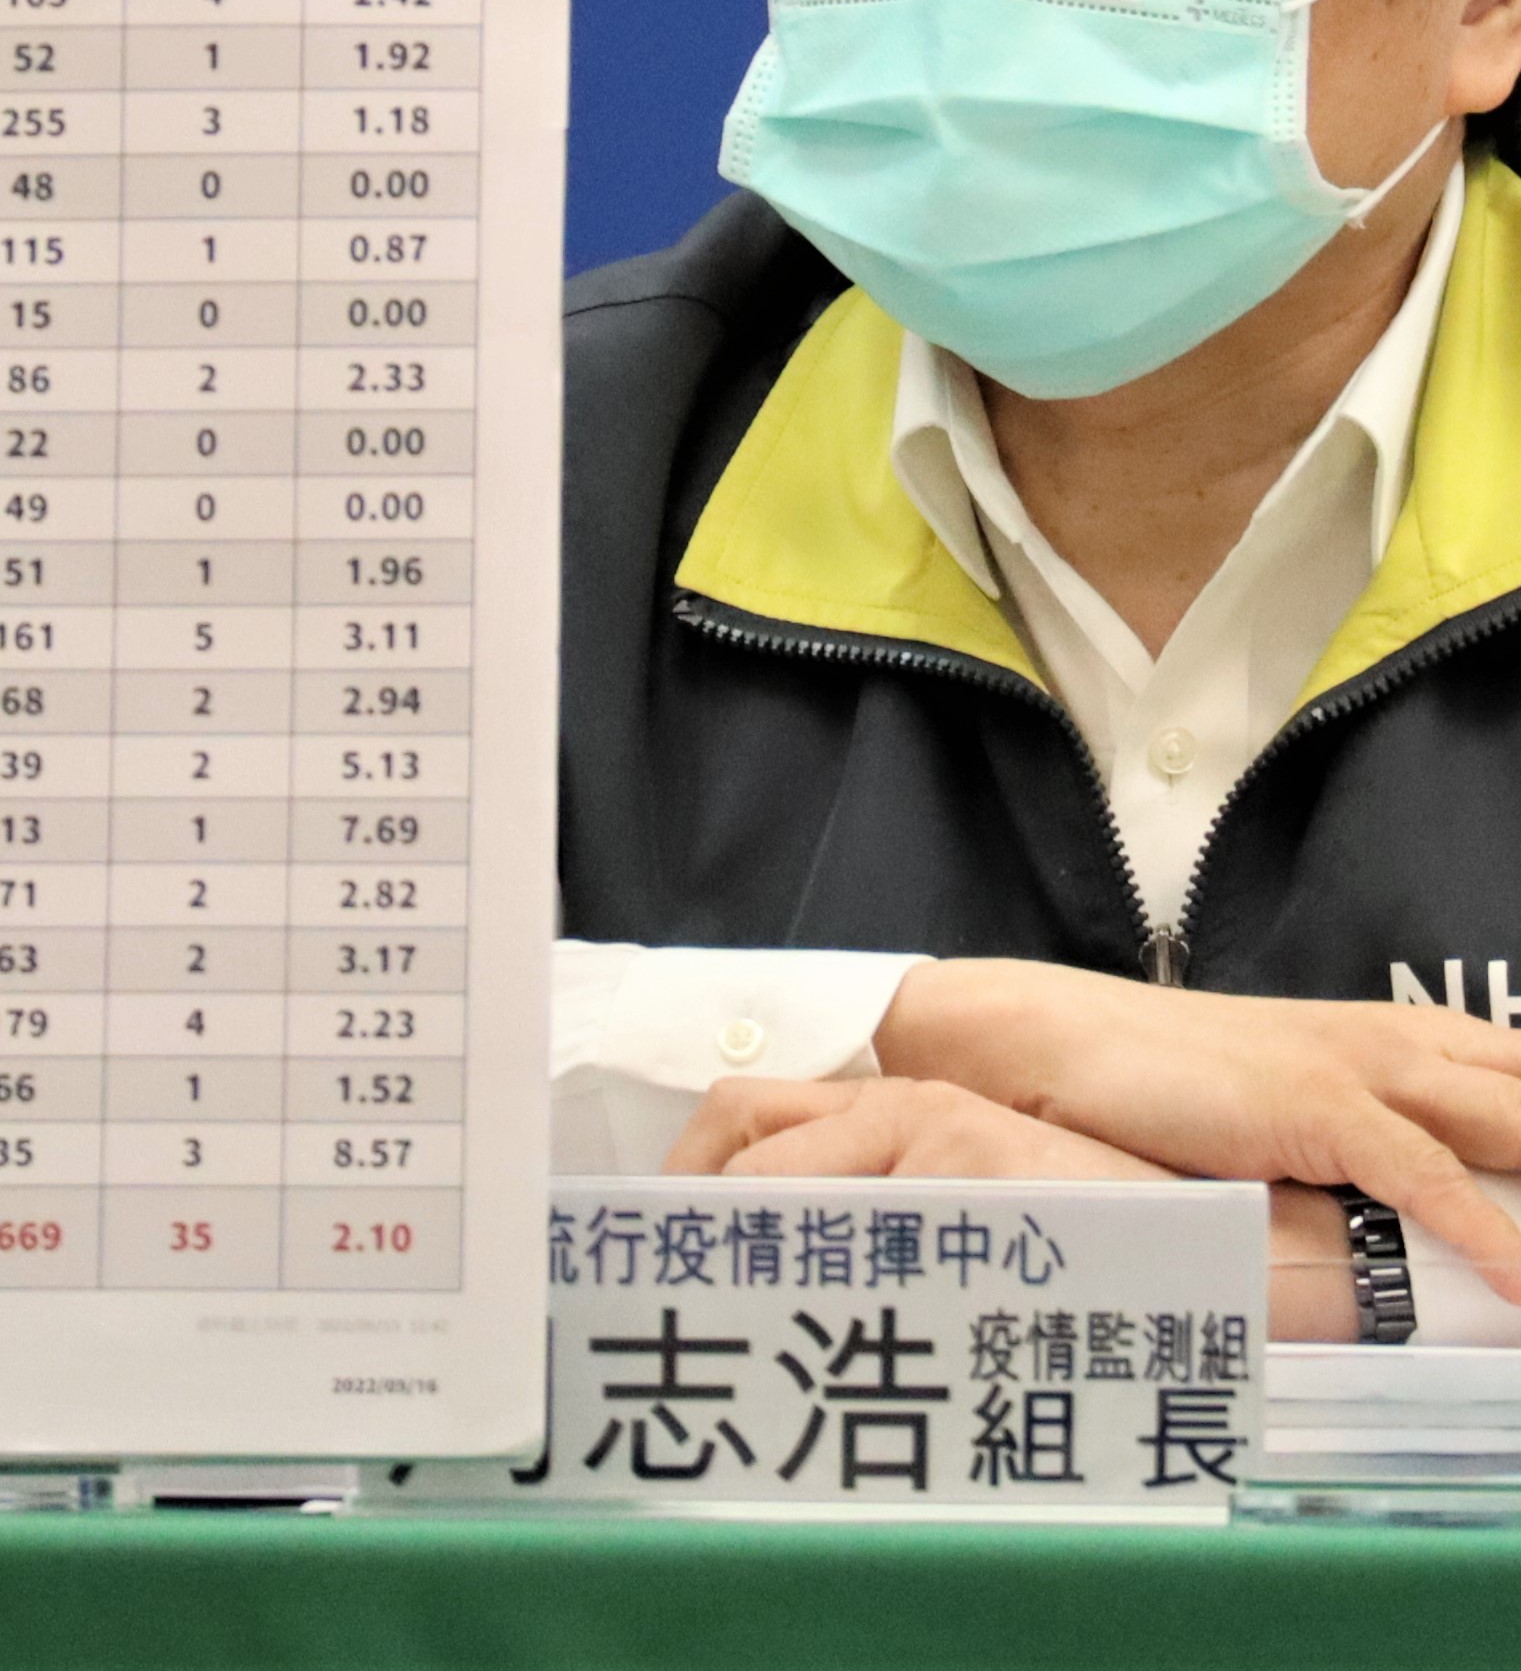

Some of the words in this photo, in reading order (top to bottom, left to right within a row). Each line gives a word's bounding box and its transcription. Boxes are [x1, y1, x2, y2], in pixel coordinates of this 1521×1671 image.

[14, 42, 55, 74] 52
[355, 41, 430, 71] 1.92
[1, 107, 67, 138] 255
[202, 106, 222, 136] 3
[354, 106, 430, 135] 1.18
[11, 172, 54, 202] 48
[349, 169, 430, 200] 0.00
[2, 236, 65, 266] 115
[349, 234, 428, 264] 0.87
[11, 300, 52, 331] 15
[347, 298, 428, 329] 0.00
[7, 364, 51, 394] 86
[198, 363, 217, 394] 2
[348, 362, 426, 393] 2.33
[6, 428, 48, 459] 22
[345, 426, 426, 457] 0.00
[4, 493, 49, 523] 49
[344, 491, 425, 522] 0.00
[4, 557, 44, 588] 51
[347, 556, 424, 587] 1.96
[195, 622, 214, 652] 5
[345, 621, 418, 652] 3.11
[0, 686, 45, 716] 68
[193, 686, 212, 717] 2
[343, 686, 422, 716] 2.94
[0, 750, 43, 781] 39
[192, 750, 211, 781] 2
[342, 750, 420, 781] 5.13
[1, 815, 41, 845] 13
[342, 815, 420, 845] 7.69
[188, 879, 208, 909] 2
[340, 879, 417, 910] 2.82
[187, 943, 206, 974] 2
[338, 944, 417, 975] 3.17
[185, 1009, 206, 1036] 4
[337, 1009, 415, 1040] 2.23
[338, 1074, 414, 1105] 1.52
[183, 1137, 203, 1168] 3
[333, 1138, 413, 1169] 8.57
[170, 1221, 213, 1252] 35
[332, 1222, 413, 1253] 2.10
[968, 1309, 1251, 1384] 疫情監測組
[388, 1306, 951, 1492] 志浩
[968, 1385, 1250, 1489] 組長
